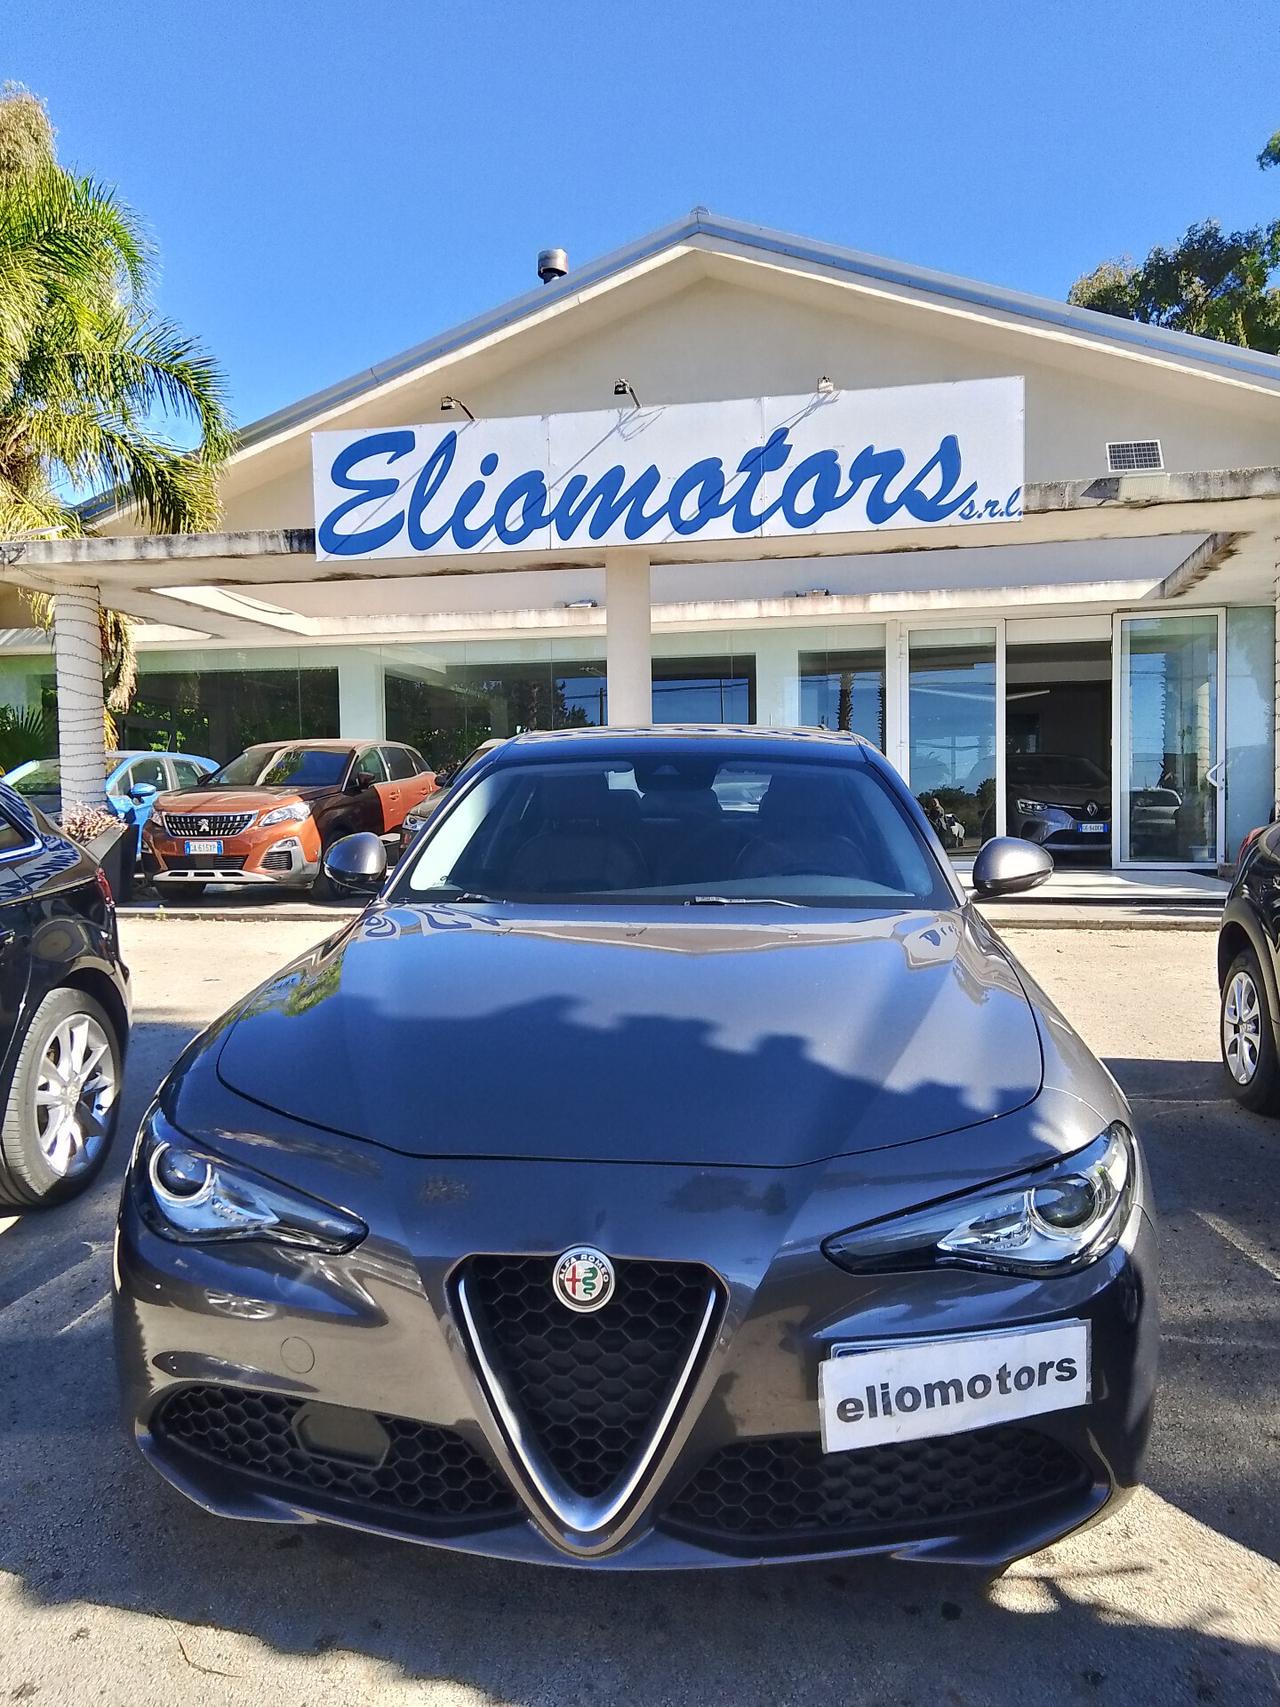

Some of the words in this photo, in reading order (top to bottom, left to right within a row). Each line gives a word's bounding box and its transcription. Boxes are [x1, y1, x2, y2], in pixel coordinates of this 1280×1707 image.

[318, 427, 978, 556] Eliomotors
[958, 485, 1023, 520] s.r.l.
[559, 1256, 577, 1280] ALFA
[580, 1254, 609, 1283] ROMEO
[836, 1356, 1078, 1424] eliomotors
